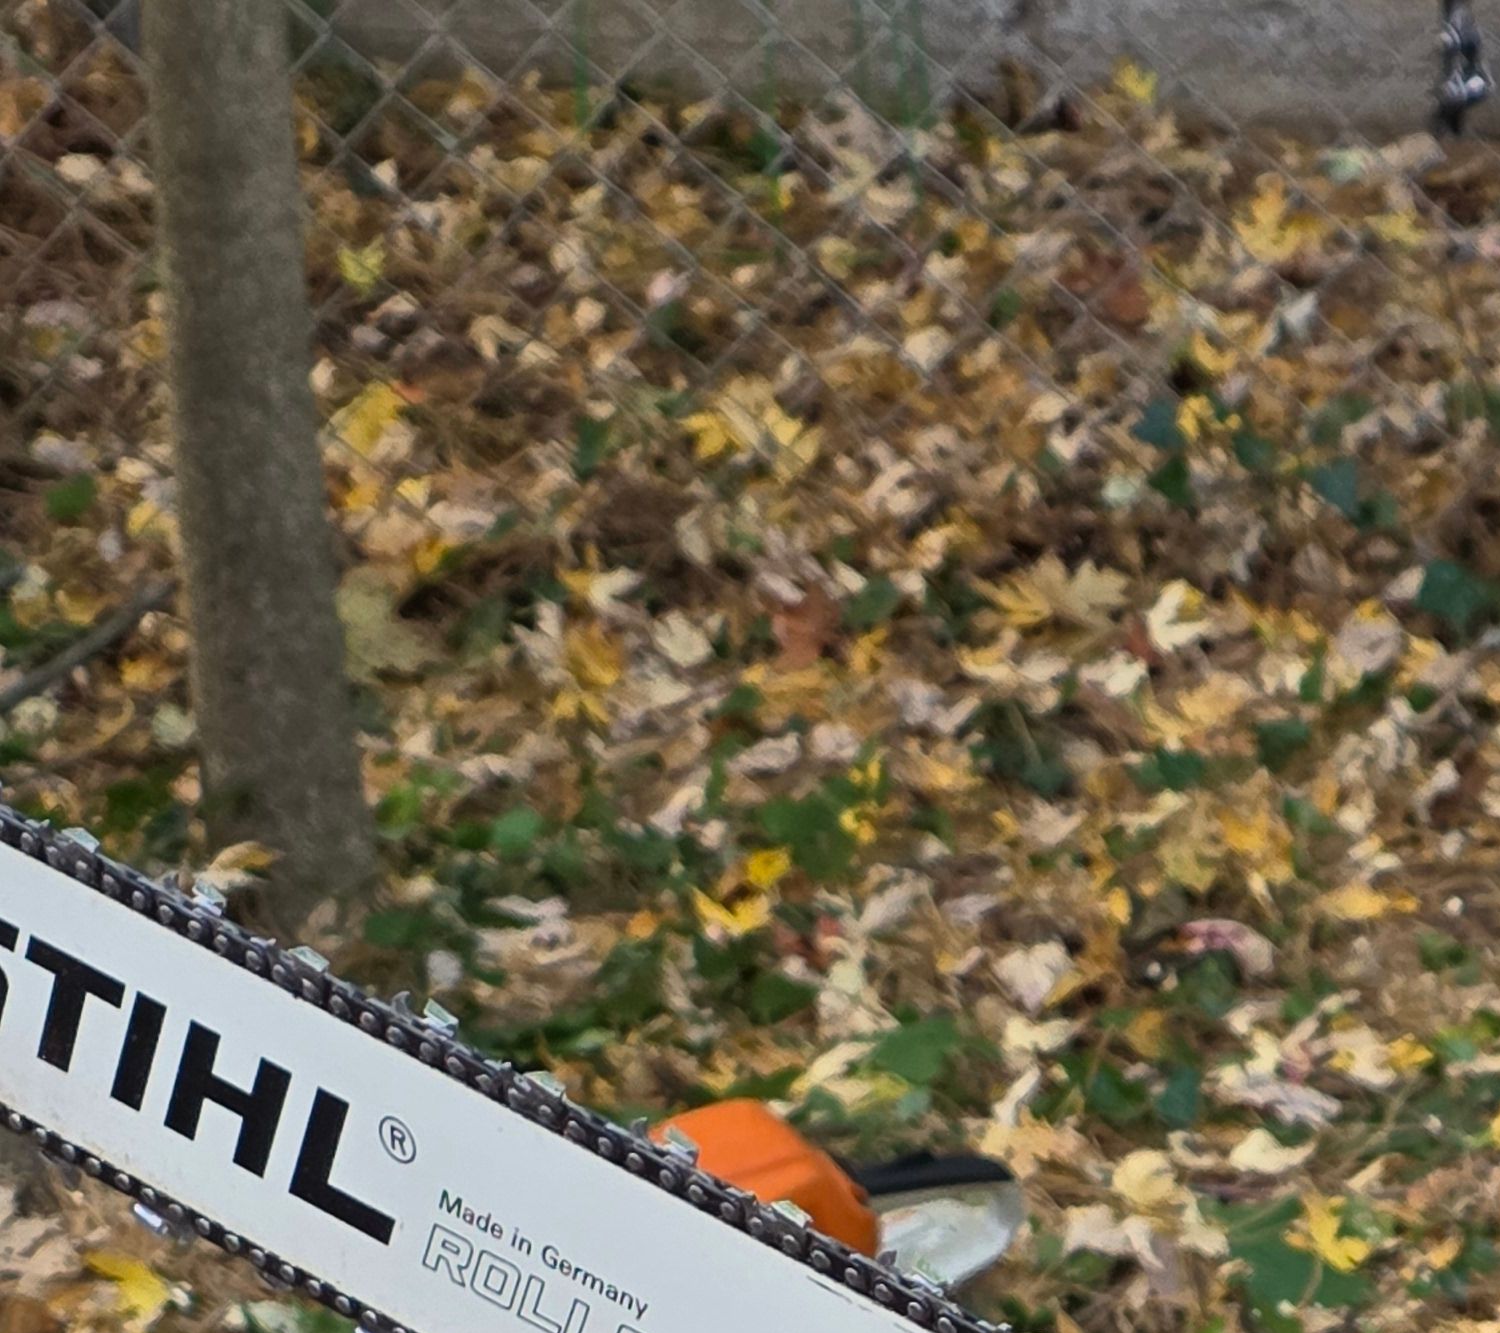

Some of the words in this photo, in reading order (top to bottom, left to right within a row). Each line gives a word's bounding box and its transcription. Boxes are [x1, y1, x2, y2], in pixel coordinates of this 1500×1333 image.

[438, 1189, 503, 1239] Made
[511, 1227, 532, 1256] in
[541, 1245, 648, 1320] Germany
